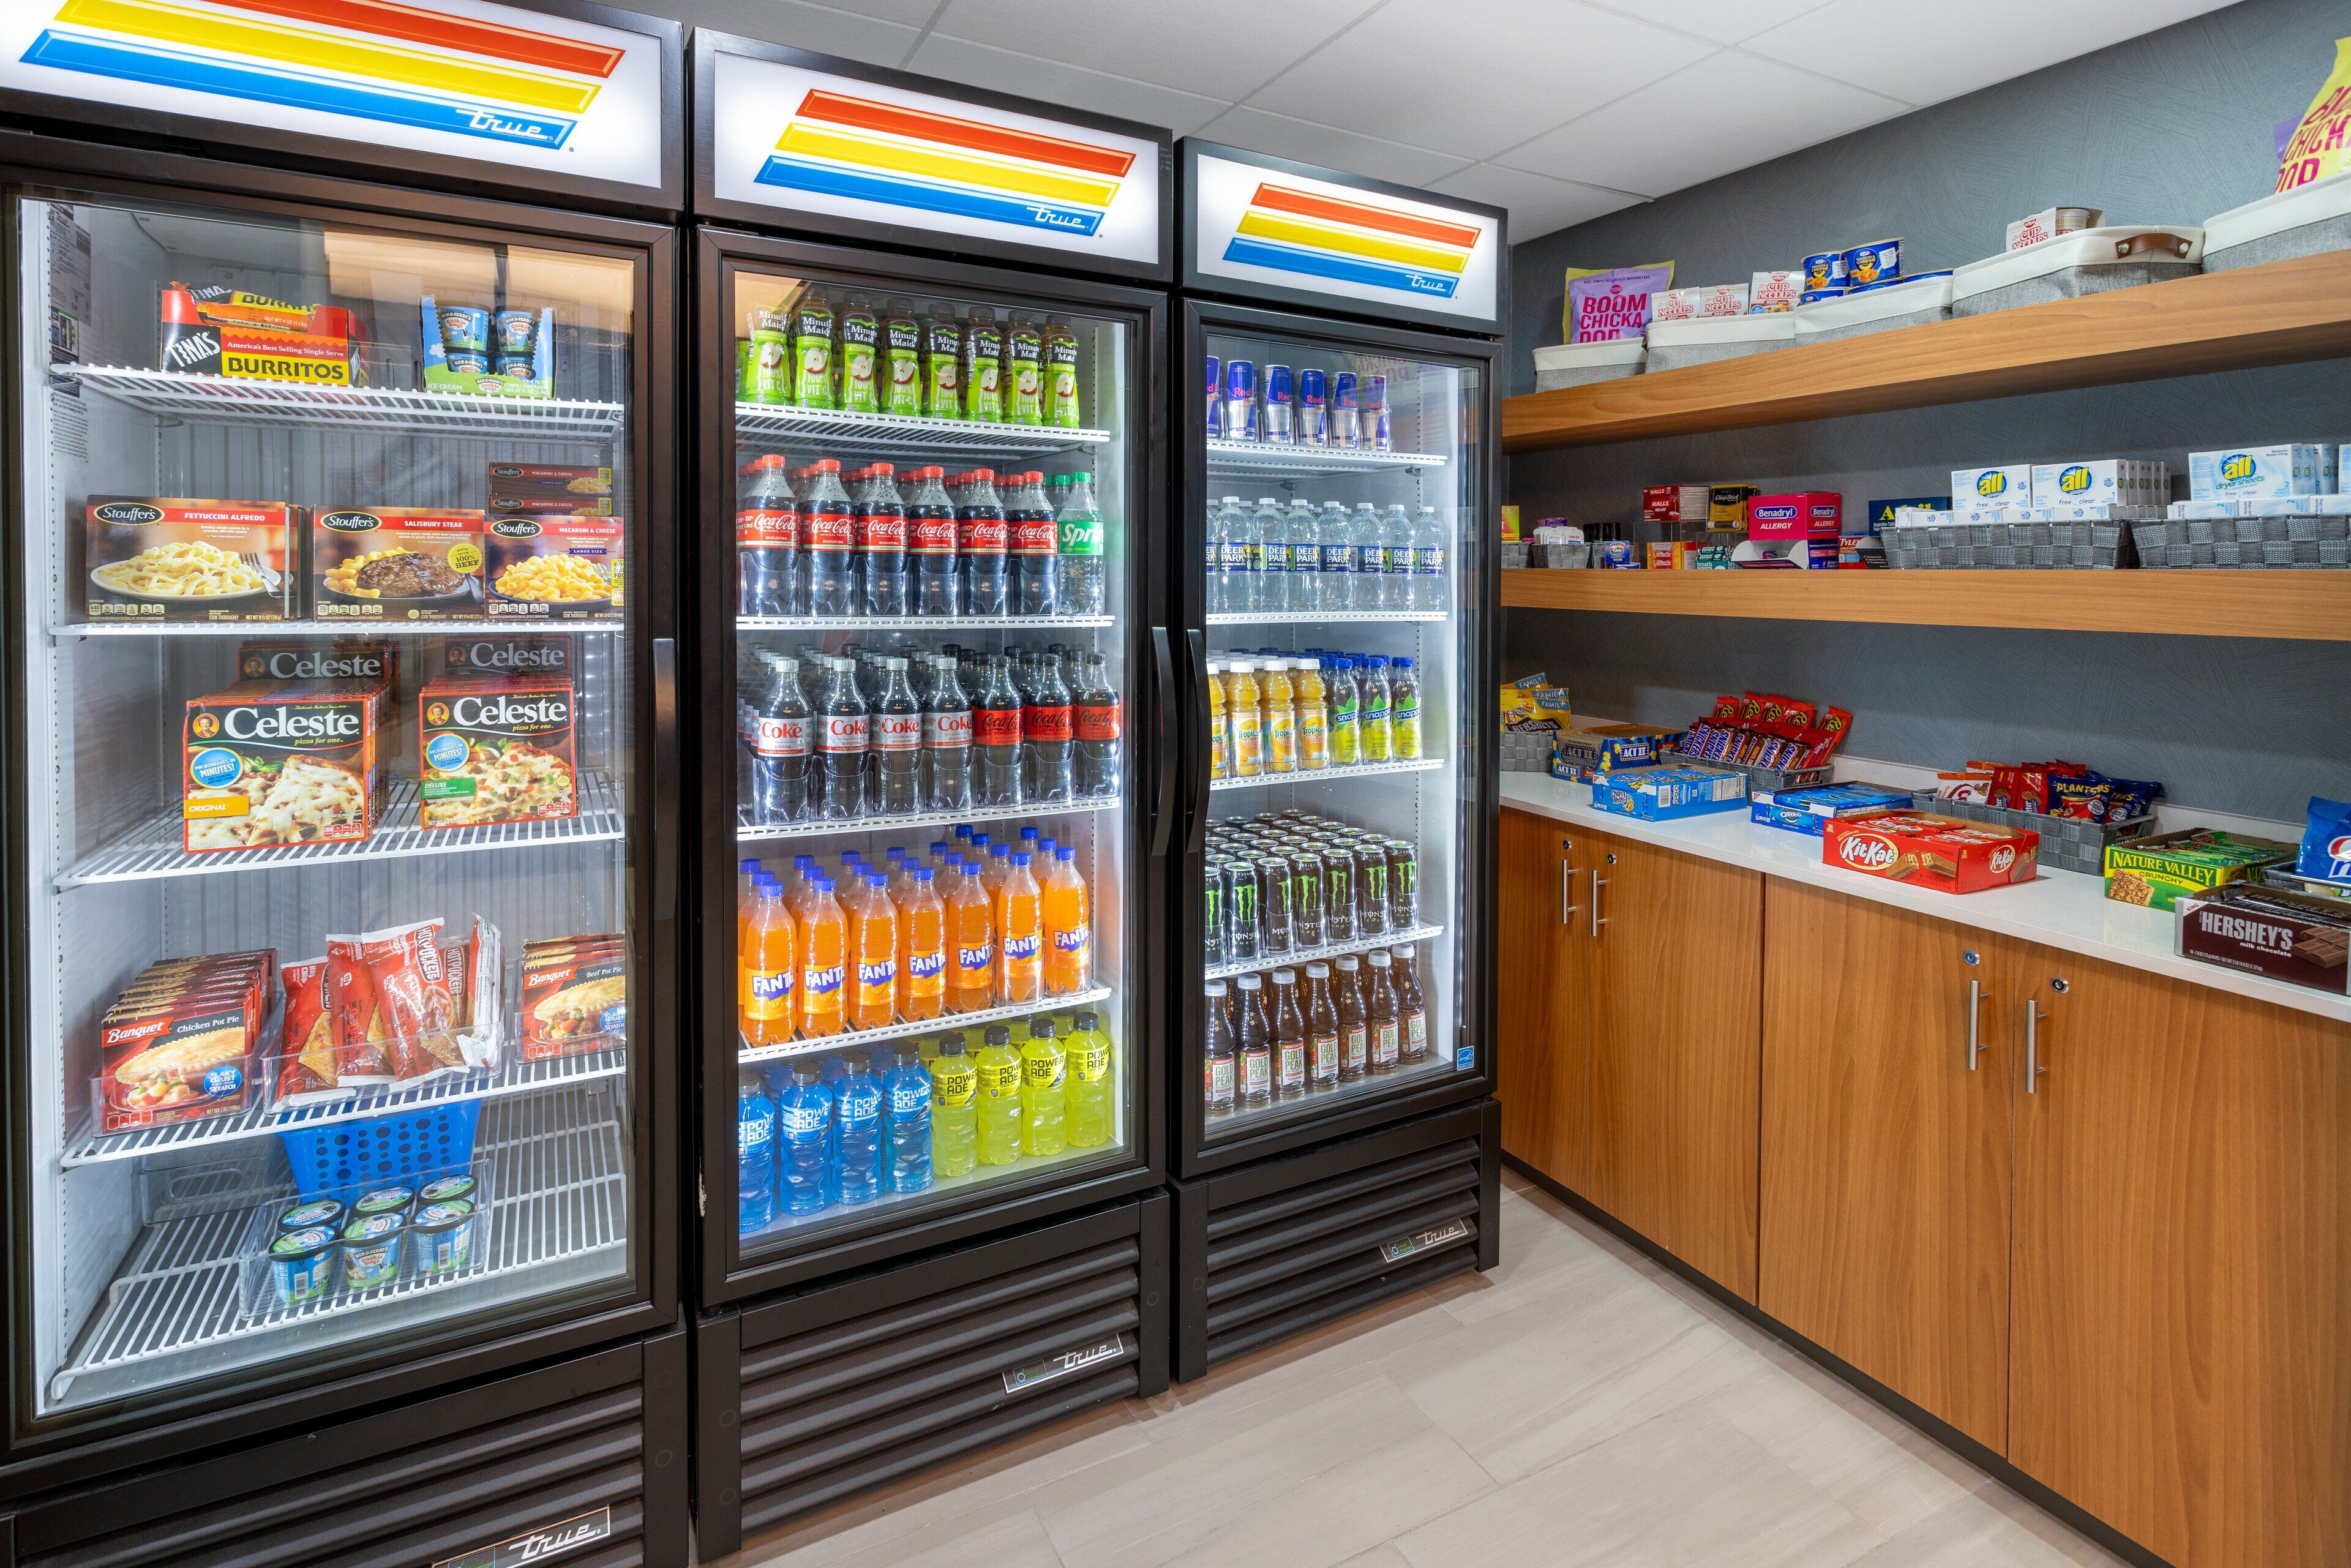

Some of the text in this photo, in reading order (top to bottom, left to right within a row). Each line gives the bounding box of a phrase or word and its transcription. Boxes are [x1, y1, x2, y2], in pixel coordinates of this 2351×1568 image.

[455, 108, 549, 140] true
[1026, 206, 1086, 228] true
[2020, 226, 2041, 241] CUP
[1406, 274, 1446, 292] true
[1766, 282, 1790, 292] CUP
[1714, 294, 1734, 304] CUP
[1757, 290, 1797, 300] NOODLES
[1583, 293, 1647, 314] BOOM
[1665, 299, 1685, 309] CUP
[1704, 301, 1742, 313] NOODLES
[1657, 305, 1694, 318] NOODLES
[1580, 312, 1642, 330] CHICKA
[166, 331, 221, 368] TINA'S
[228, 357, 344, 380] BURRITOS
[1234, 387, 1251, 396] Red
[1307, 394, 1322, 404] Red
[2224, 455, 2252, 481] all
[1978, 471, 2004, 495] all
[2060, 467, 2090, 490] all
[2216, 475, 2265, 490] dryer sheets
[103, 507, 156, 521] Stouffer's
[184, 512, 228, 520] FETTUCCINI
[1758, 507, 1794, 519] Benadryl
[1813, 507, 1835, 517] Benadryl
[328, 514, 374, 528] Stouffer's
[754, 513, 797, 530] Coca-Cola
[812, 517, 853, 534] Coca-Cola
[868, 520, 906, 535] Coca-Cola
[497, 522, 536, 535] Stouffer's
[917, 523, 956, 539] Coca-Cola
[1221, 546, 1244, 555] DEER
[455, 558, 479, 569] BEEF
[456, 554, 475, 563] 100%
[1221, 553, 1245, 562] PARK
[1297, 554, 1317, 563] PARK
[471, 643, 565, 667] Celeste
[270, 651, 382, 678] Celeste
[1519, 677, 1542, 688] FAMILY
[454, 697, 567, 727] Celeste
[225, 706, 360, 740] Celeste
[762, 721, 803, 738] Coke
[830, 719, 869, 735] Coke
[882, 718, 920, 733] Coke
[938, 716, 972, 731] Coke
[315, 737, 326, 745] for
[429, 745, 457, 756] MICROWAVES
[433, 748, 463, 762] MINUTES!
[1566, 746, 1581, 757] ACT
[1623, 746, 1646, 758] ACT II
[195, 759, 229, 771] MICROWAVES
[200, 764, 235, 778] MINUTES!
[2057, 781, 2110, 794] PLANTERS
[189, 804, 227, 813] ORIGINAL
[2112, 852, 2214, 887] NATURE VALLEY
[2139, 871, 2184, 886] CRUNCHY
[2186, 902, 2199, 912] KING
[2201, 911, 2293, 951] HERSHEY'S
[2240, 941, 2292, 958] milk chocolate
[858, 959, 897, 979] FANTA
[528, 968, 573, 987] Banquet
[177, 1021, 211, 1033] Chicken
[1411, 1018, 1426, 1029] GOLD
[107, 1021, 166, 1044] Banquet
[1411, 1028, 1426, 1038] PEAK
[1284, 1049, 1303, 1061] GOLD
[1321, 1043, 1337, 1054] GOLD
[1031, 1056, 1065, 1068] POWER
[1250, 1057, 1268, 1069] GOLD
[1284, 1058, 1303, 1070] PEAK
[1321, 1052, 1338, 1063] PEAK
[1031, 1068, 1051, 1077] ADE
[1250, 1067, 1269, 1078] PEAK
[893, 1084, 932, 1100] POWER
[947, 1085, 969, 1093] ADE
[894, 1101, 918, 1109] ADE
[797, 1119, 821, 1129] ADE
[509, 1523, 597, 1559] true
